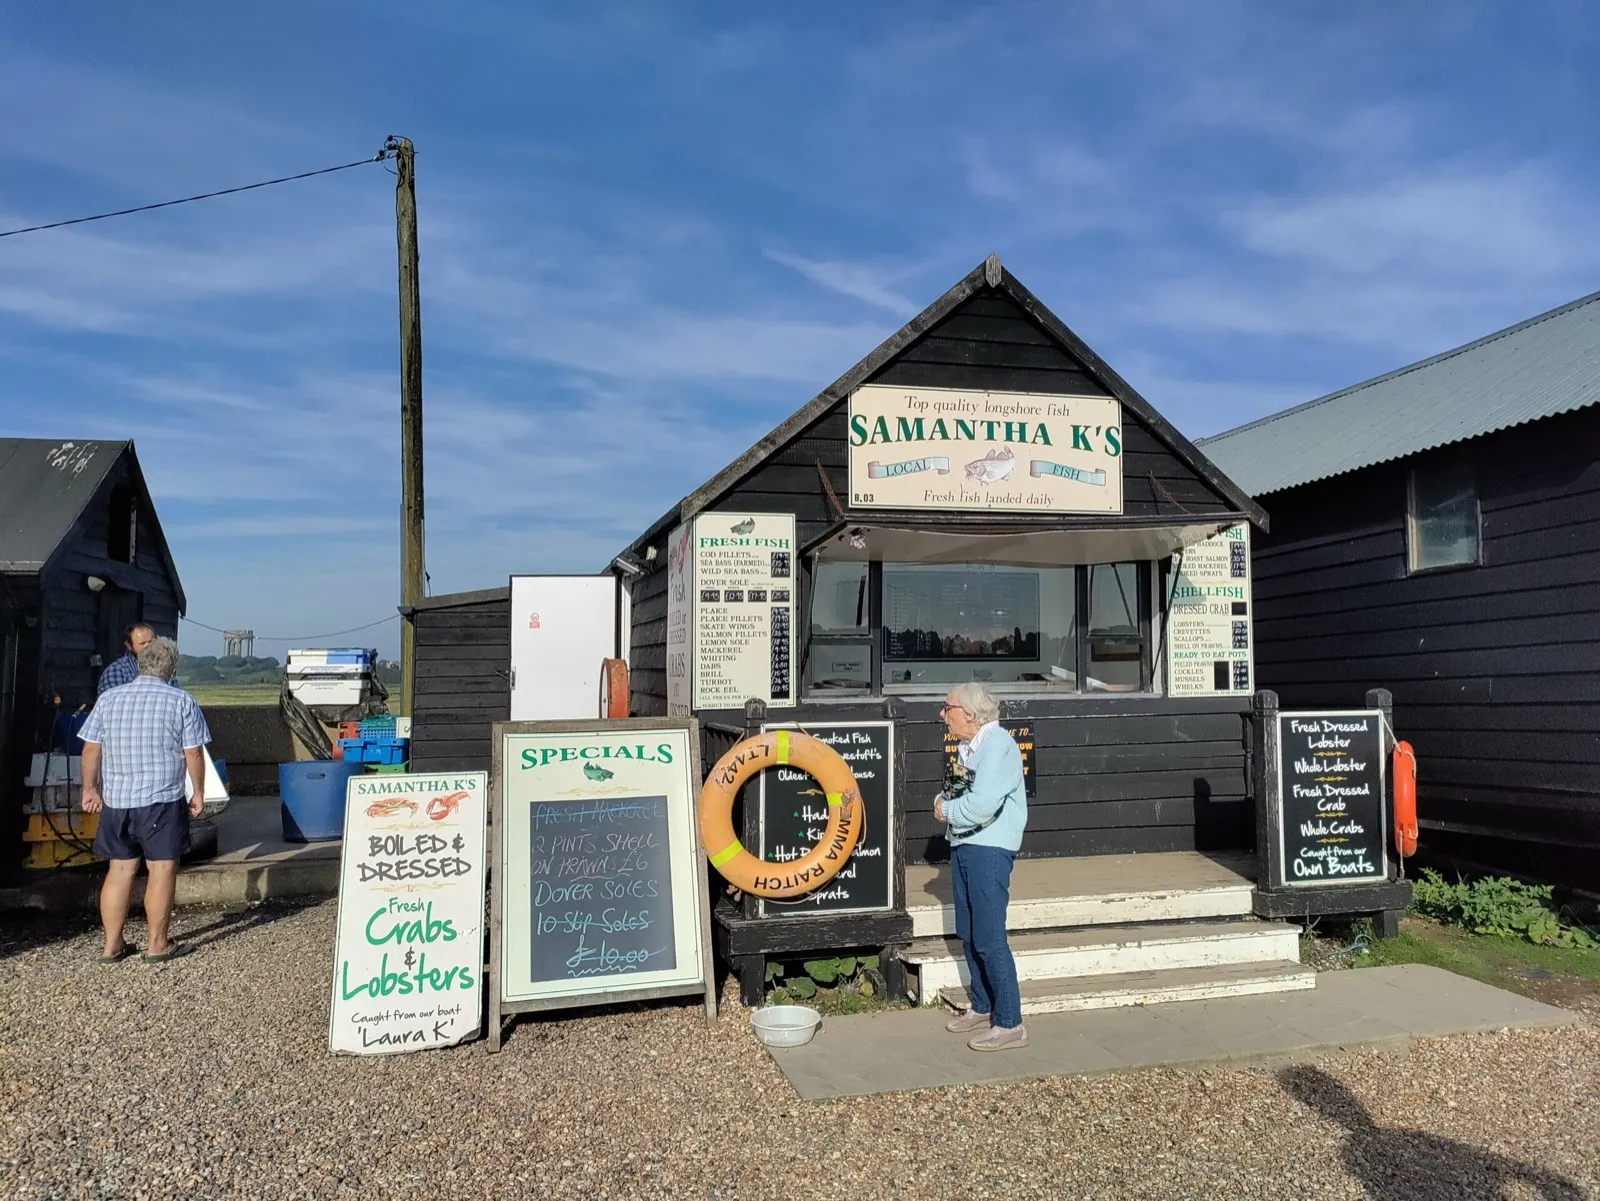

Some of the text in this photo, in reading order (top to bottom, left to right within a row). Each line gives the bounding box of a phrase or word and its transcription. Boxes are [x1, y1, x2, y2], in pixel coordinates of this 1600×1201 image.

[904, 396, 1070, 417] Top quality longshore fish
[850, 414, 1121, 457] SAMANTHA K'S
[885, 459, 931, 476] LOCAL
[1052, 465, 1081, 480] FISH
[854, 493, 875, 503] B.03
[924, 490, 1054, 508] Fresh fish landed daily
[700, 538, 790, 549] FRESH FISH
[1173, 587, 1244, 599] SHELLFISH
[1173, 604, 1230, 615] DRESSED CRAB
[1290, 719, 1368, 733] Fresh Dressed
[852, 732, 872, 744] Fish
[1308, 734, 1351, 749] Lobster
[521, 743, 673, 771] SPECIALS
[1294, 757, 1366, 774] Whole Lobster
[778, 769, 810, 781] Oldest
[357, 779, 477, 795] SAMANTHA K'S
[1293, 783, 1370, 798] Fresh Dressed
[1317, 798, 1346, 811] Crab
[1300, 819, 1364, 837] Whole Crabs
[368, 833, 465, 857] BOILED &
[532, 836, 546, 853] 2
[551, 833, 597, 855] PINTS
[775, 845, 798, 862] Hot
[1300, 846, 1367, 861] Caught from our
[357, 857, 472, 883] DRESSED
[532, 857, 553, 876] ON
[617, 851, 648, 874] £6
[1294, 856, 1375, 877] Own Boats
[753, 862, 825, 890] RAITCH
[534, 880, 594, 907] DOVER
[388, 896, 425, 914] Fresh
[365, 901, 458, 946] Crabs
[537, 912, 557, 935] 10
[404, 946, 417, 970] &
[342, 952, 474, 1001] Lobsters
[351, 1010, 392, 1028] Caught
[392, 1008, 417, 1024] from
[437, 1003, 462, 1016] boat
[357, 1018, 455, 1047] 'Laura K'
